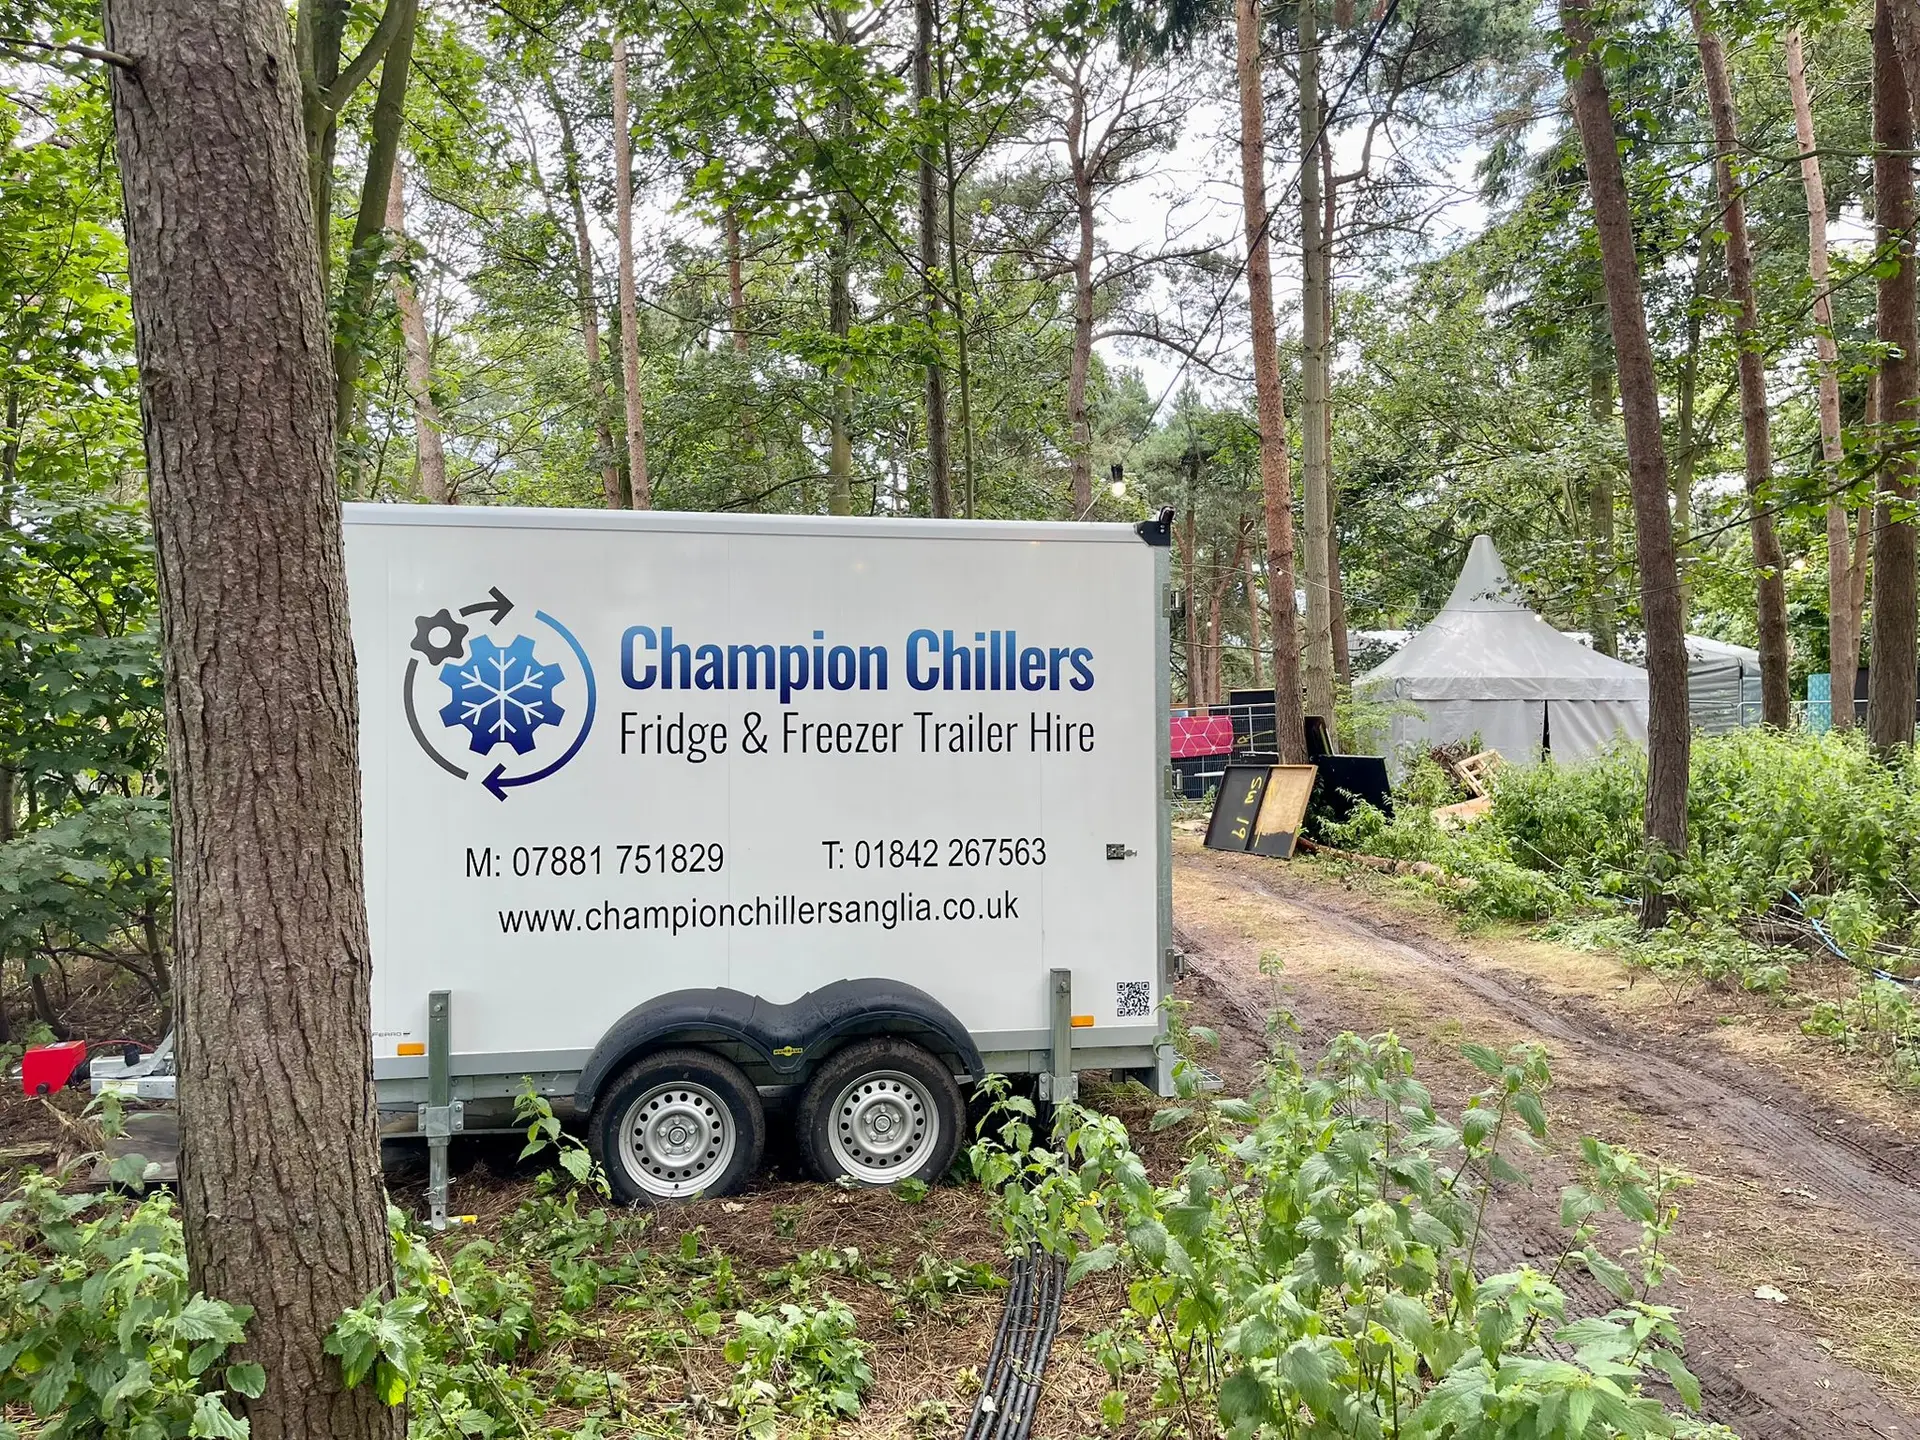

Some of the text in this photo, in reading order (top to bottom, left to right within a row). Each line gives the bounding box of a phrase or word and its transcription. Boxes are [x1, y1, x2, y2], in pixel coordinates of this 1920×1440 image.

[621, 626, 1095, 704] Champion Chillers
[621, 711, 1095, 764] Fridge & Freezer Trailer Hire
[466, 843, 724, 878] M: 07881 751829
[822, 837, 1047, 870] T: 01842 267563
[498, 889, 1019, 937] www.championchillersanglia.co.uk
